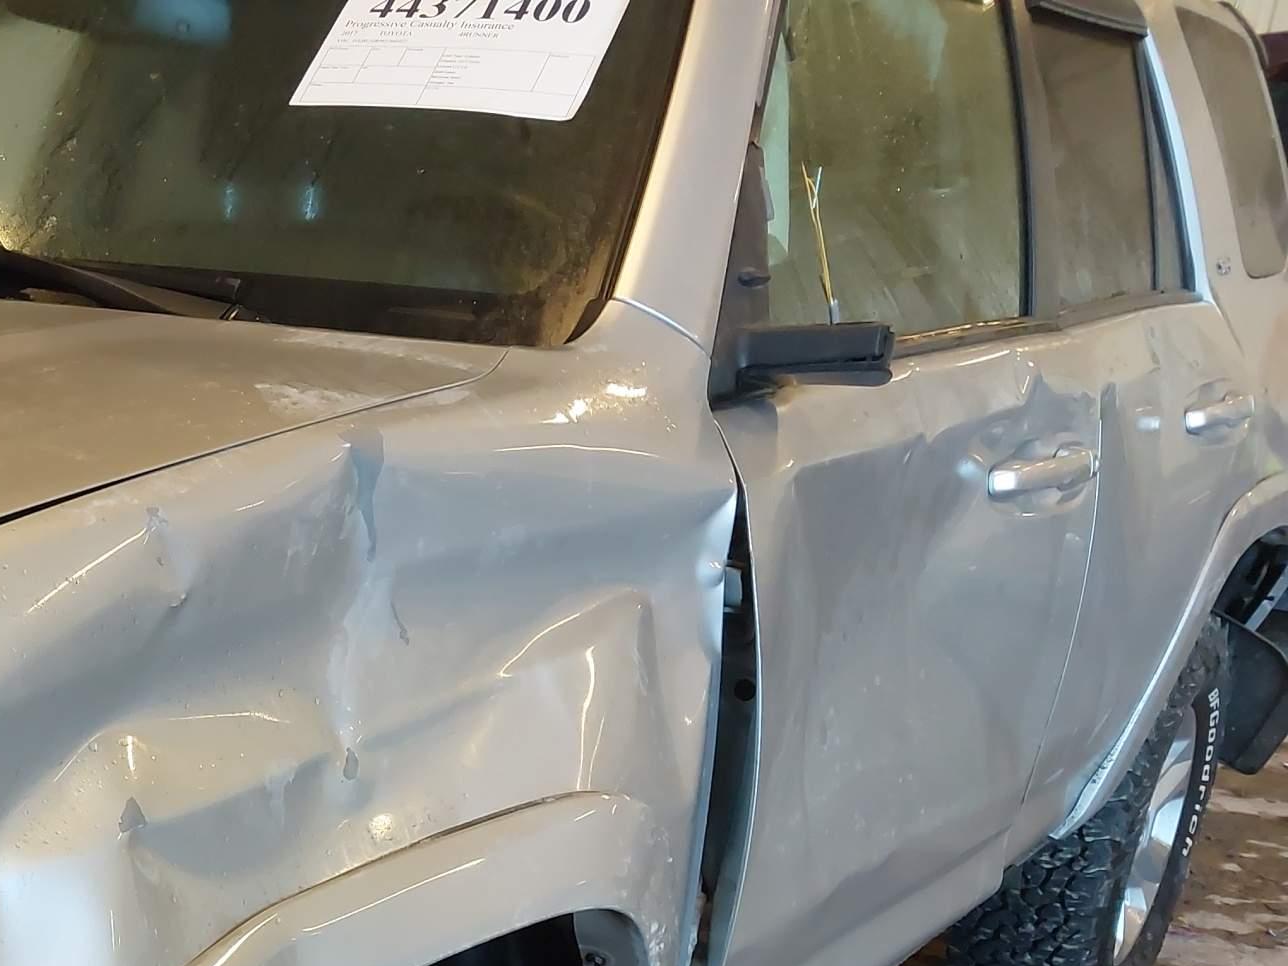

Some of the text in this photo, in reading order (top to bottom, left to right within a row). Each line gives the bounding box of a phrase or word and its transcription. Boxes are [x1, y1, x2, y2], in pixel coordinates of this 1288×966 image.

[345, 19, 515, 30] Progressive Casualty Insurance
